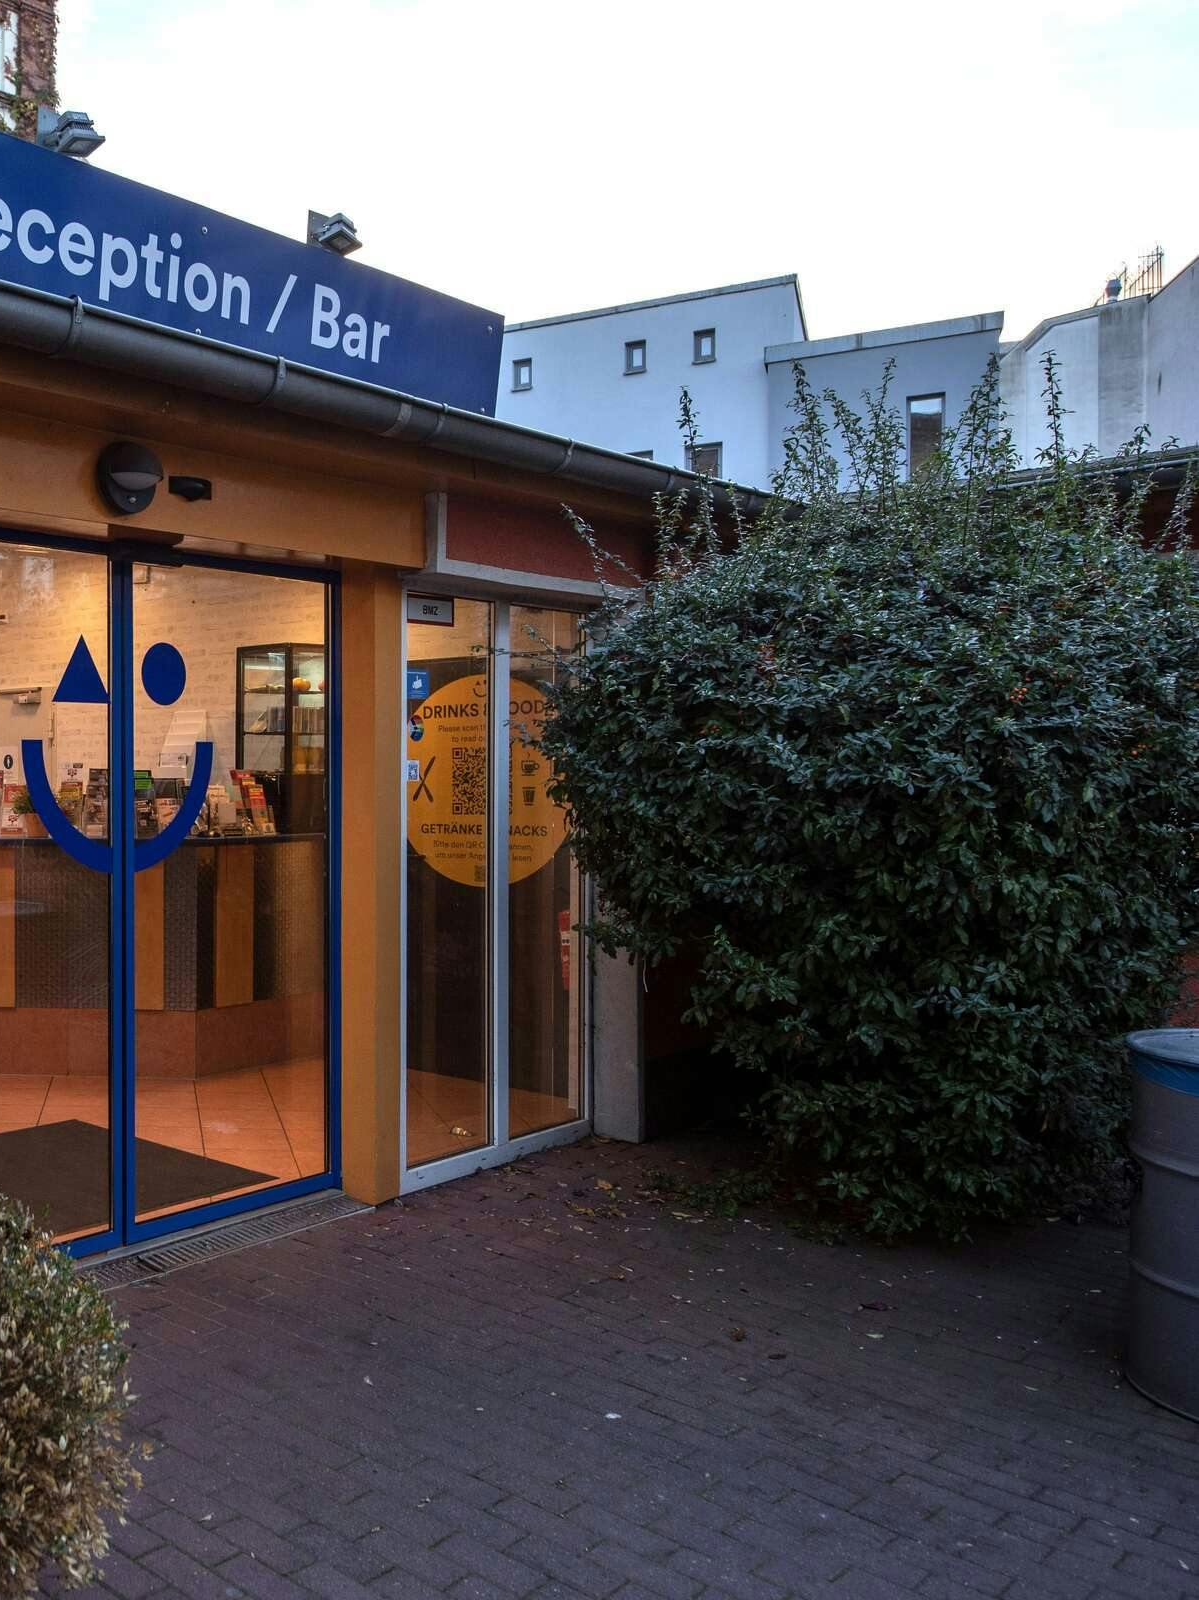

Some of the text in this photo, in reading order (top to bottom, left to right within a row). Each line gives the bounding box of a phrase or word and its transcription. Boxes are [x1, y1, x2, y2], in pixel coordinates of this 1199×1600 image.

[266, 275, 298, 333] /
[310, 284, 391, 365] Bar
[422, 604, 439, 616] BMZ
[423, 704, 479, 719] DRINKS
[509, 700, 544, 715] OOD
[421, 821, 483, 835] GETRÄNKE
